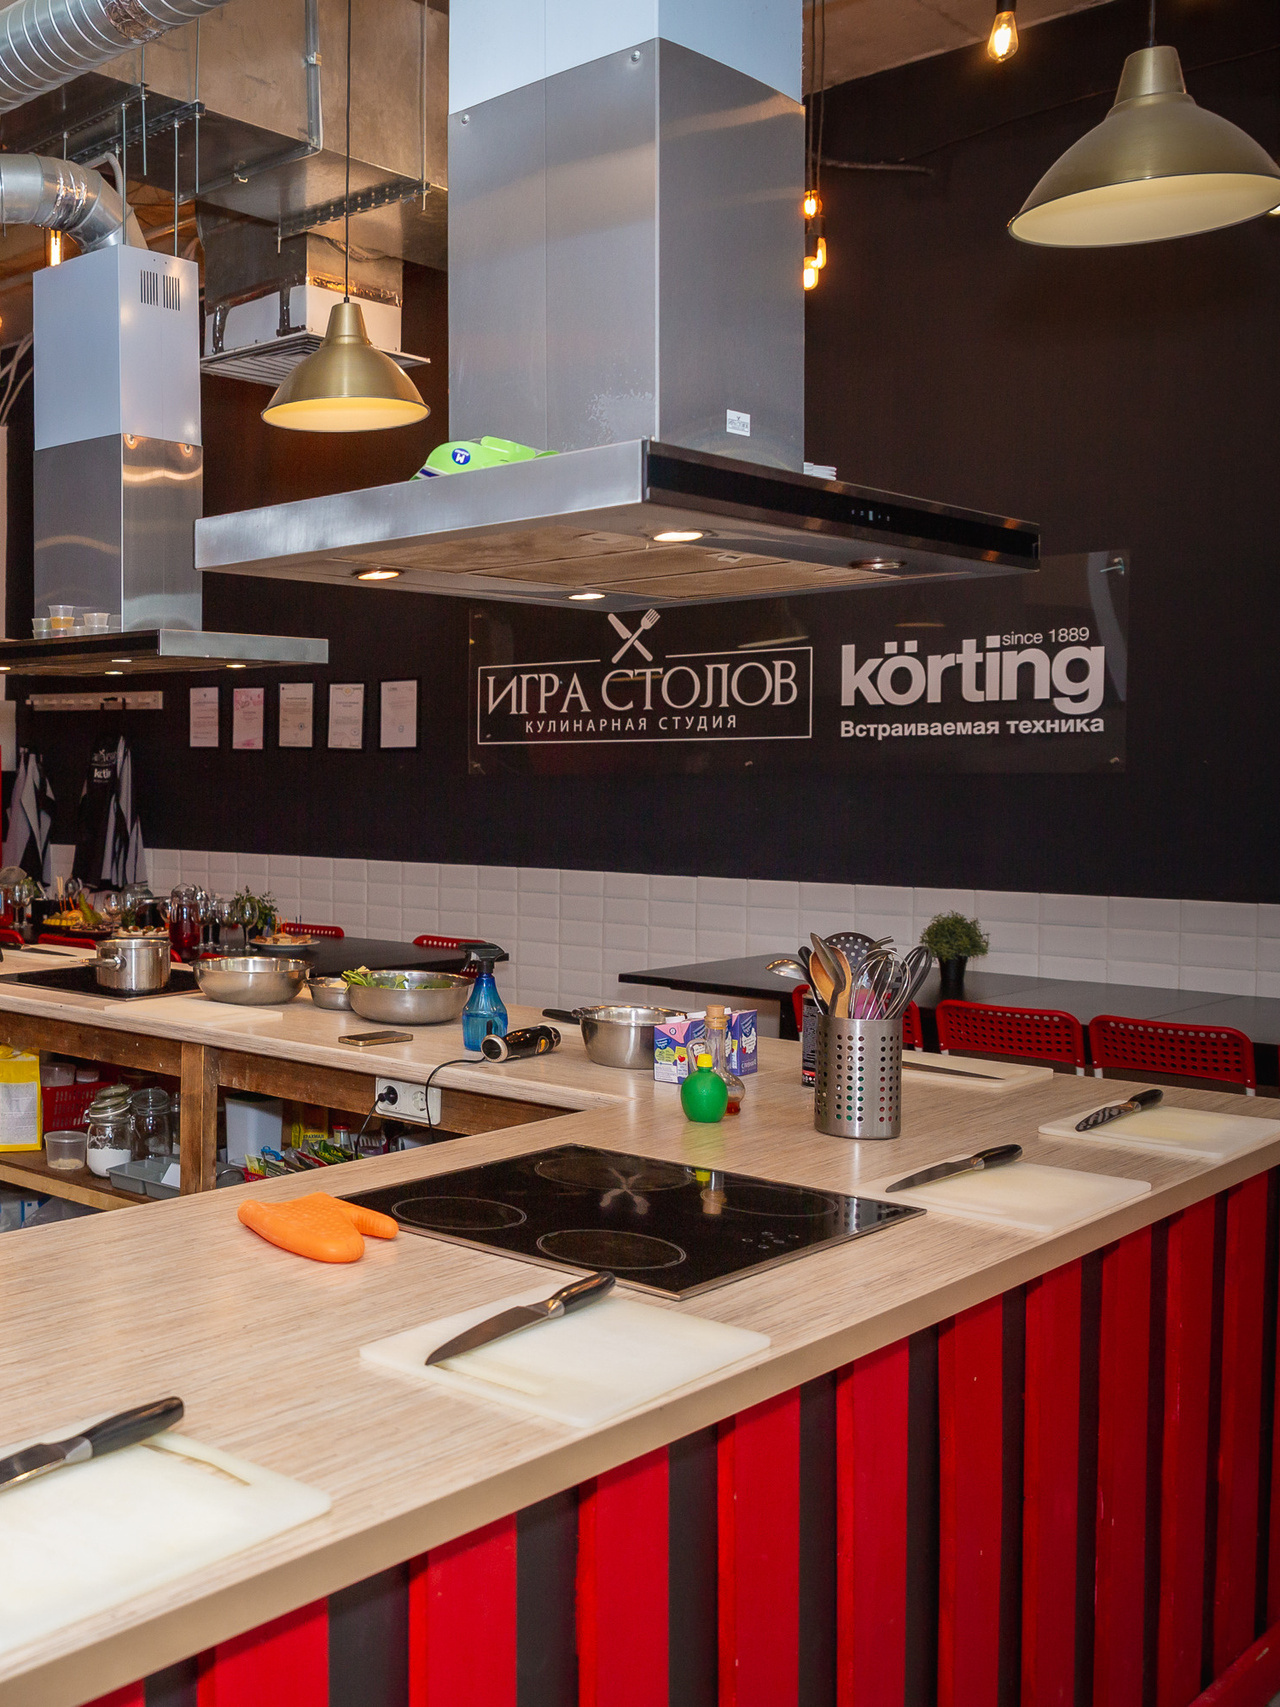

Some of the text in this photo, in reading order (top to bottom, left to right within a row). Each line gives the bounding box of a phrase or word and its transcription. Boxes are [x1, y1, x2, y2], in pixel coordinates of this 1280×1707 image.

[1002, 626, 1090, 645] since 1889
[840, 635, 1106, 715] körting
[487, 661, 798, 715] ИГРА СТОЛОВ
[525, 714, 736, 734] КУЛИНАРНАЯ СТУДИЯ
[840, 717, 1105, 741] Встраиваемая техника
